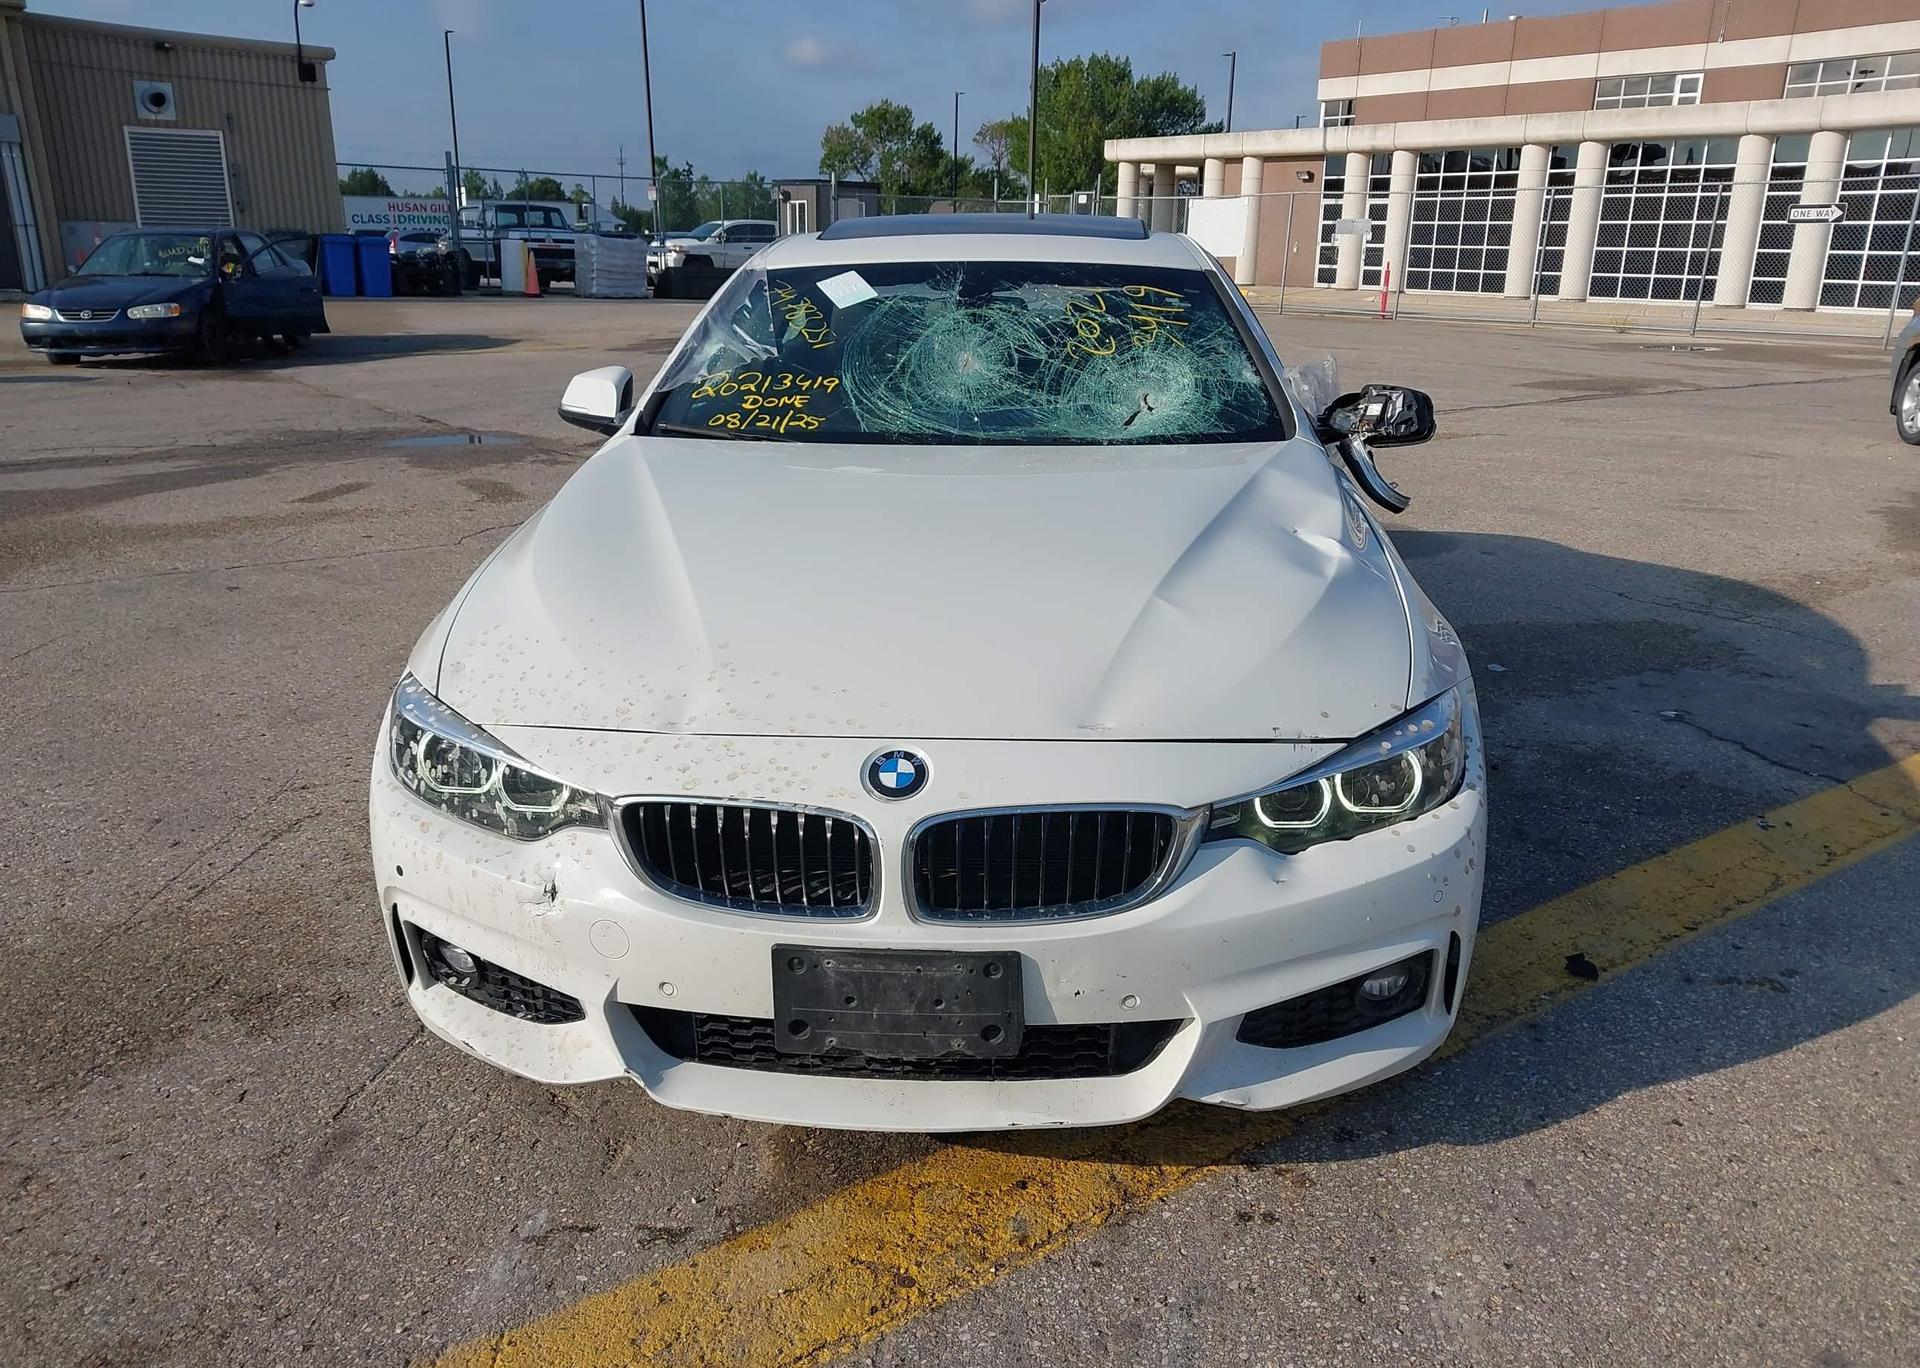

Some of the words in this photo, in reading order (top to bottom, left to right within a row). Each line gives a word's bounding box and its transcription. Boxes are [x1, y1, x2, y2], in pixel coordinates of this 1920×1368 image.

[388, 202, 427, 213] HUSAN
[430, 203, 453, 213] GIL
[1816, 209, 1836, 217] WAY
[352, 213, 391, 224] CLASS
[398, 215, 450, 225] DRIVING
[691, 369, 840, 399] 20213419
[742, 394, 810, 408] DONE
[708, 410, 826, 433] 08/21/25
[875, 751, 922, 766] BMW
